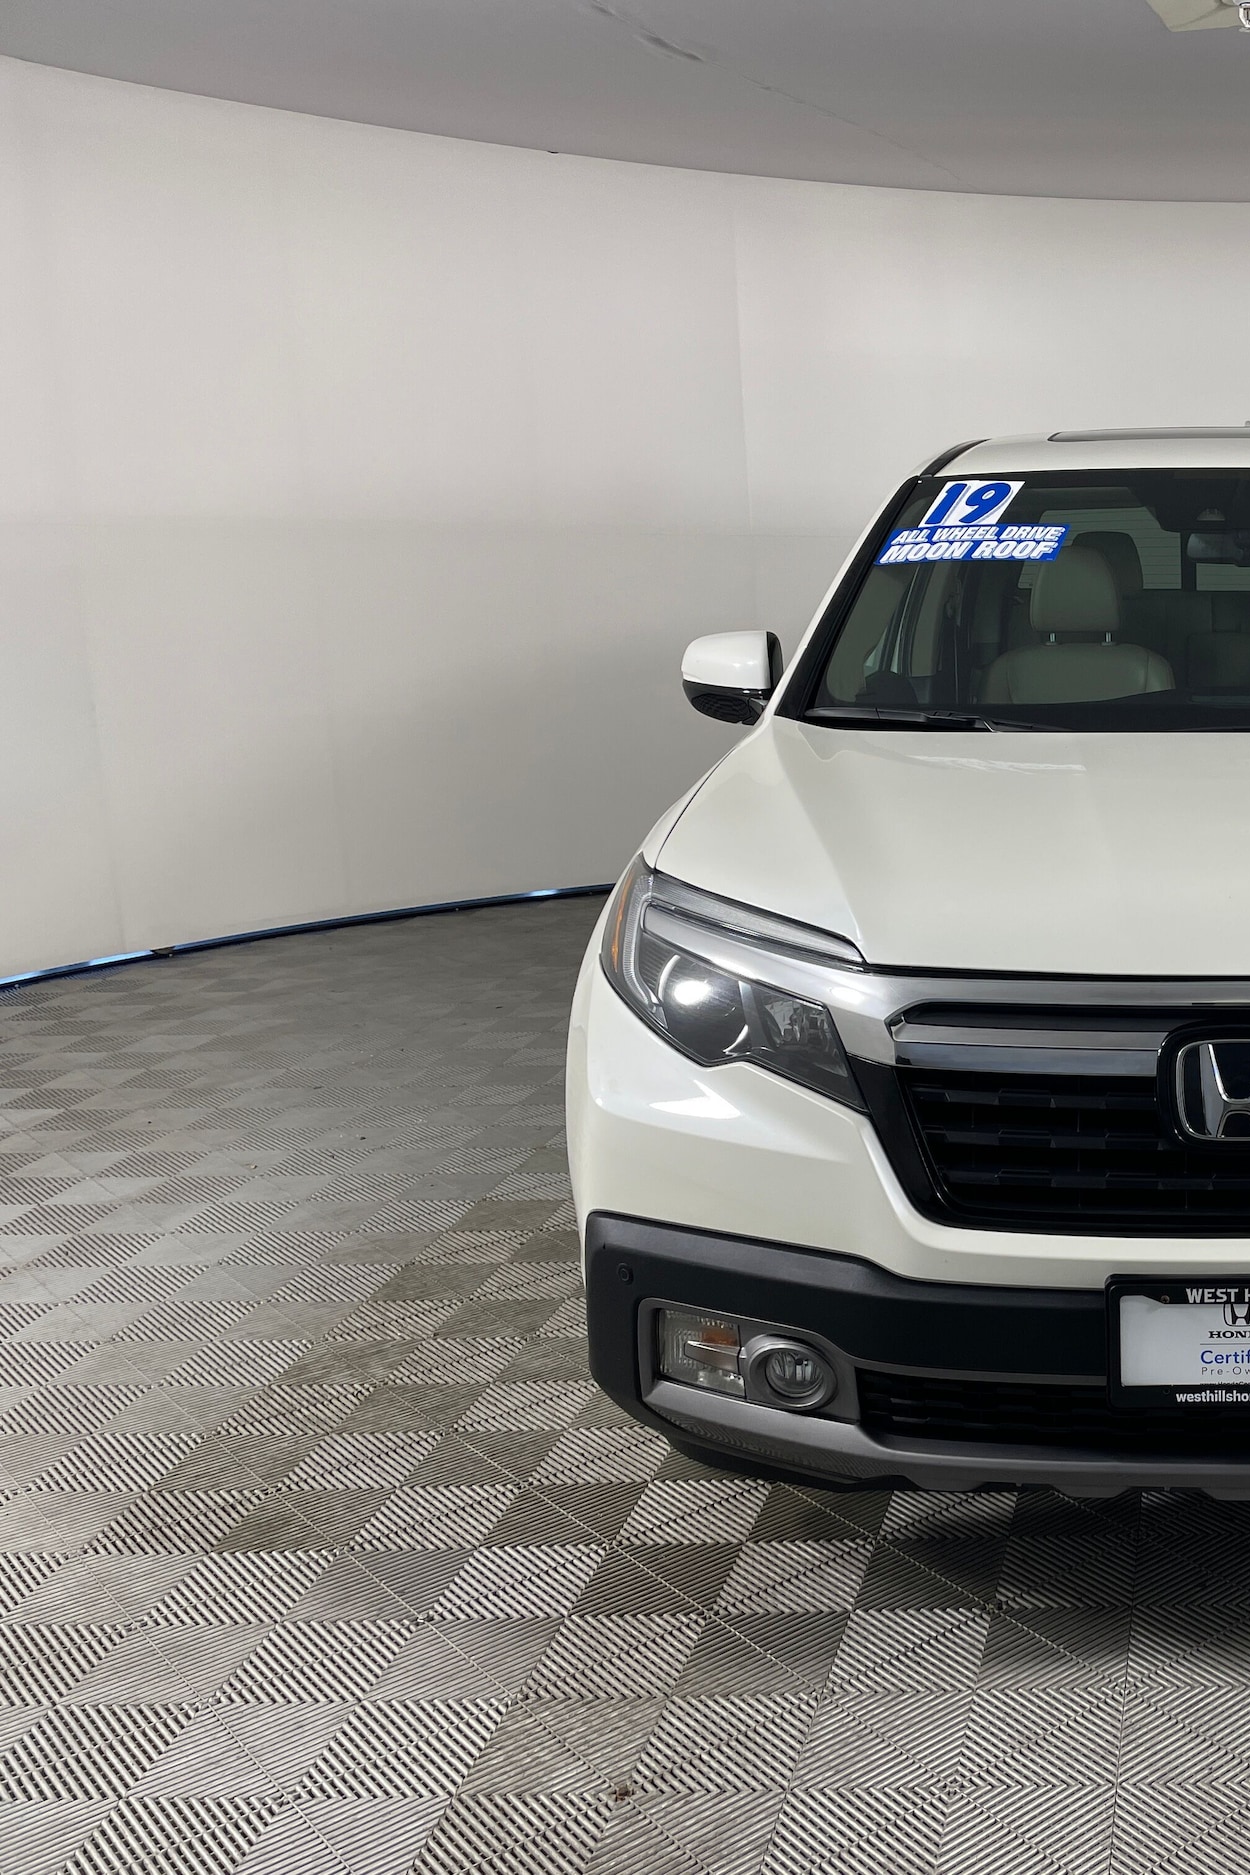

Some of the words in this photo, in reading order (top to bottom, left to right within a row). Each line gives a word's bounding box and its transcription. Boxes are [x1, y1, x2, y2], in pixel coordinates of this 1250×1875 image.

[924, 482, 1013, 525] 19
[891, 528, 931, 545] ALL
[932, 526, 1000, 542] WHEEL
[999, 526, 1066, 542] DRIVE
[879, 541, 974, 564] MOON
[971, 540, 1059, 560] ROOF
[1185, 1287, 1239, 1304] WEST
